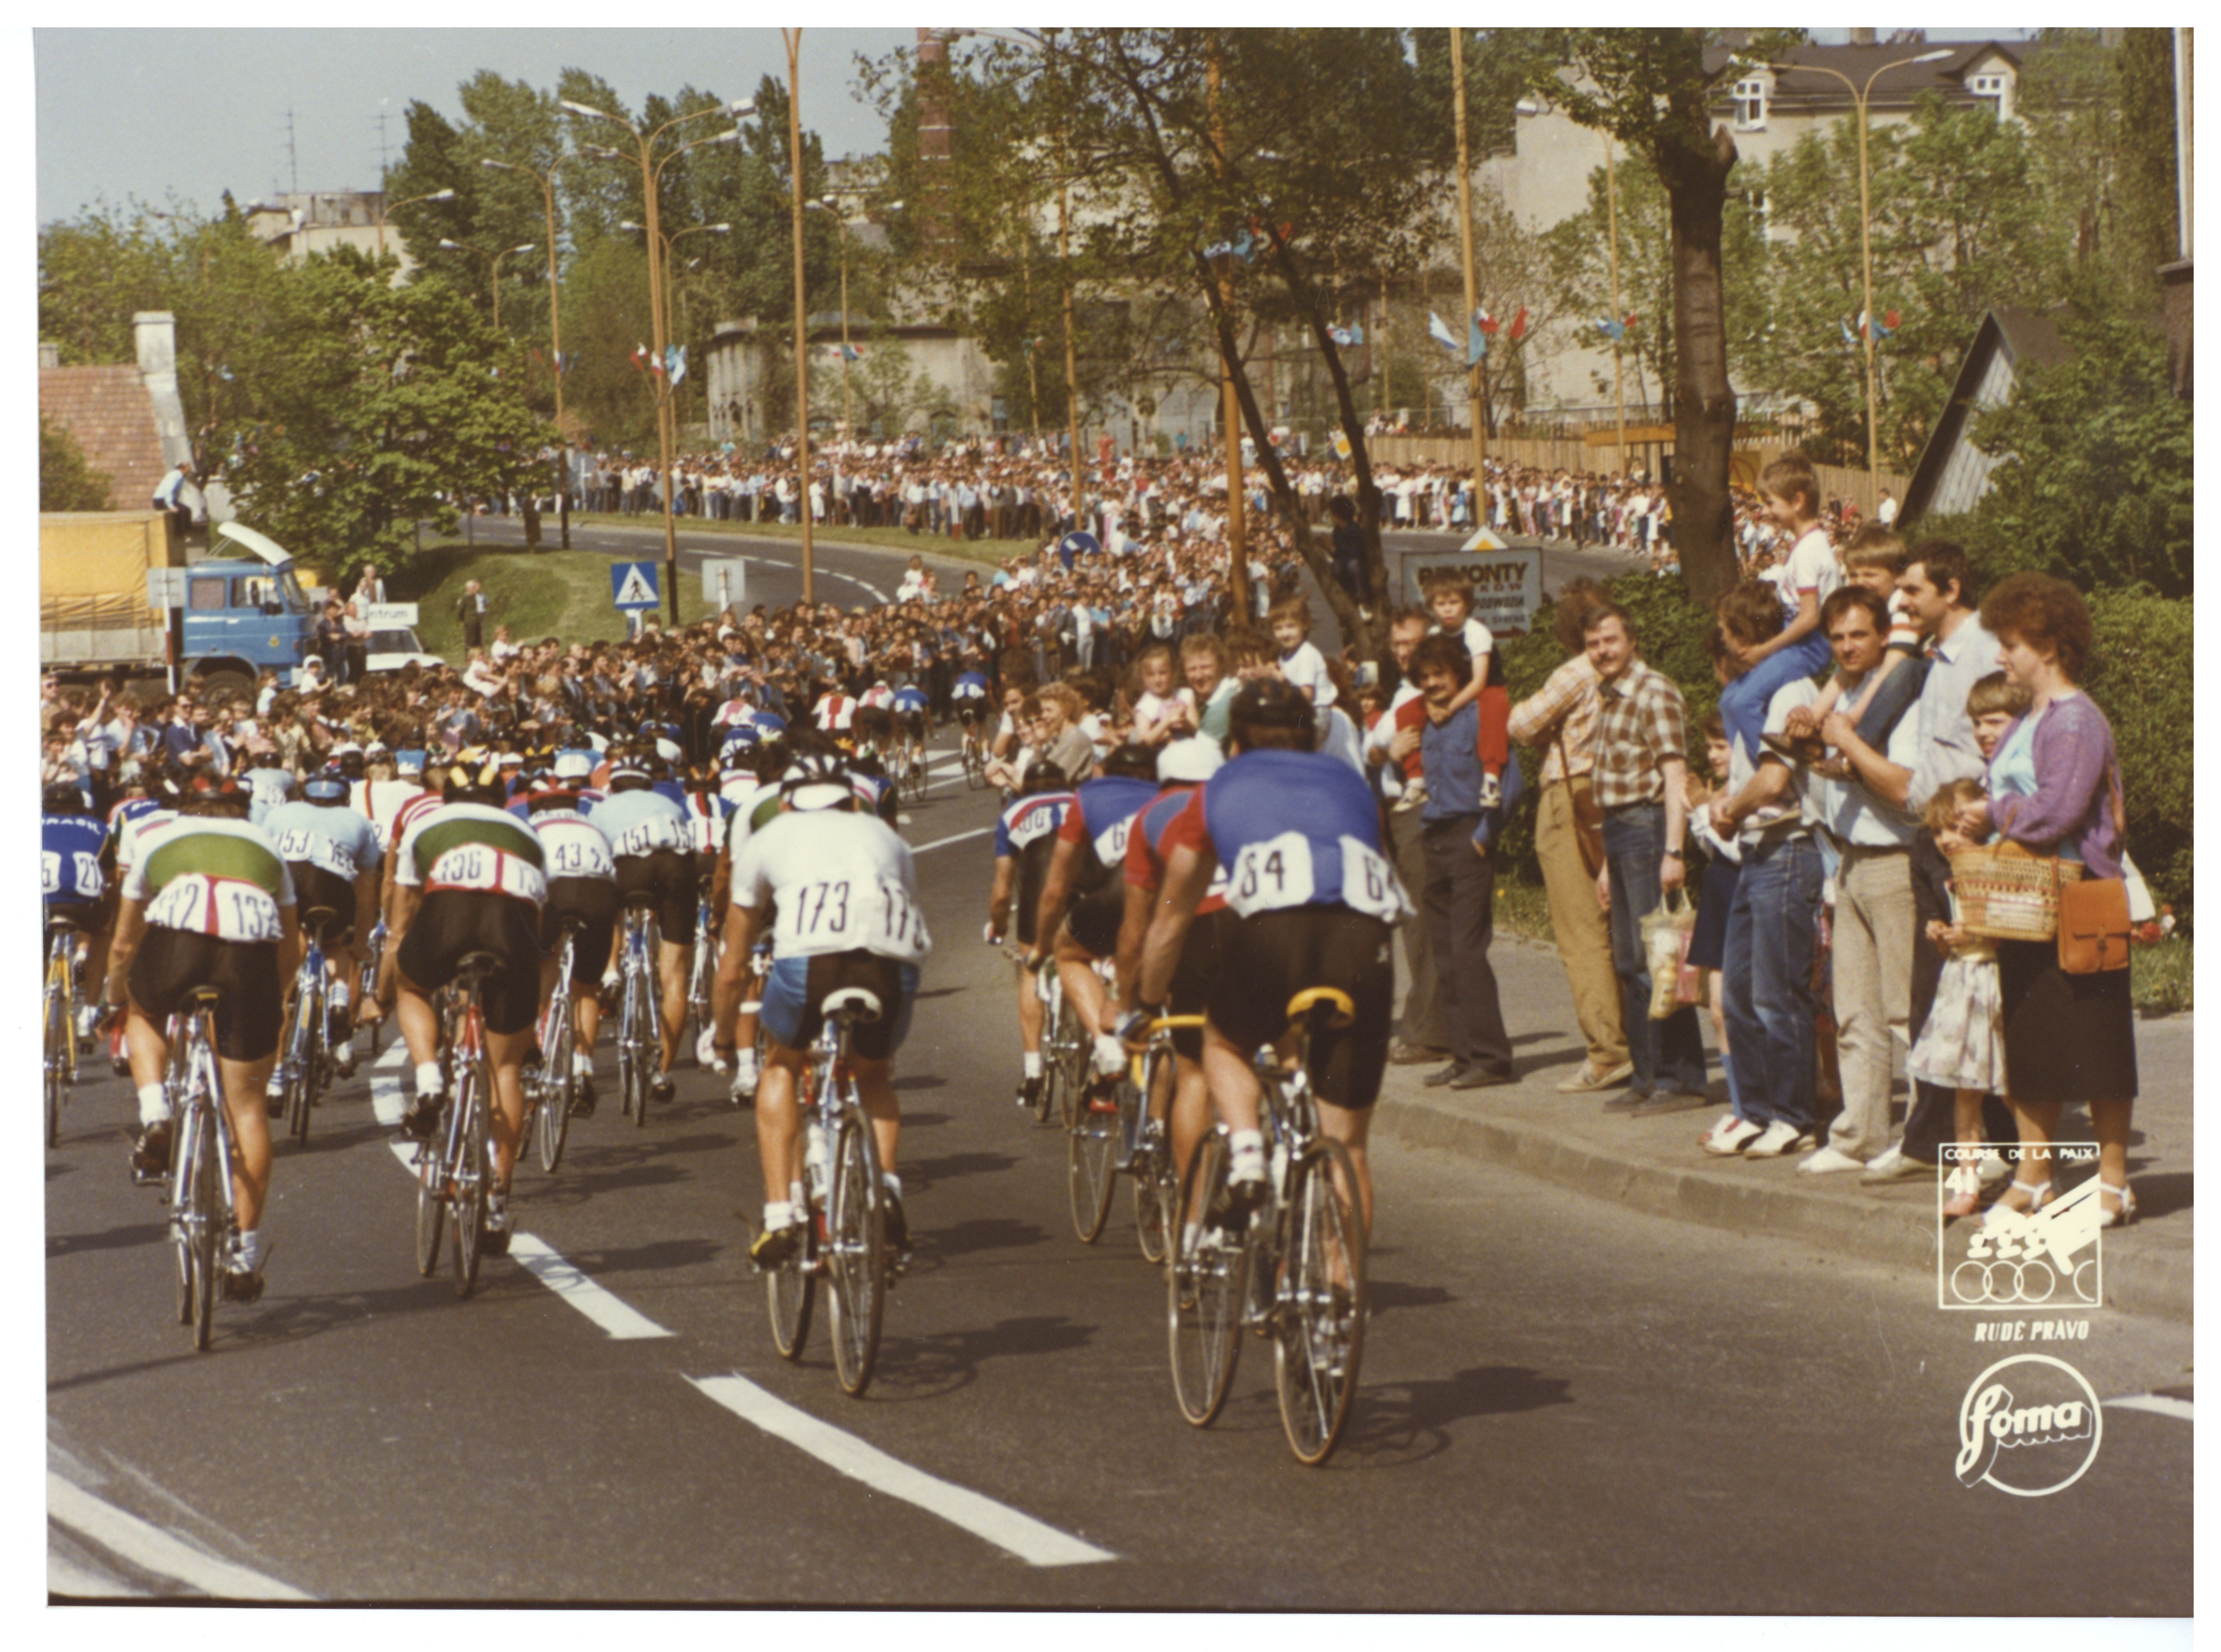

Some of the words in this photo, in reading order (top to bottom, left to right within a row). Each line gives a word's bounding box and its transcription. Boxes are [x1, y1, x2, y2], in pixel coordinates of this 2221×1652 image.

[368, 609, 408, 618] ntrum
[42, 817, 101, 836] RASIL
[555, 843, 581, 871] 43
[796, 881, 850, 936] 173
